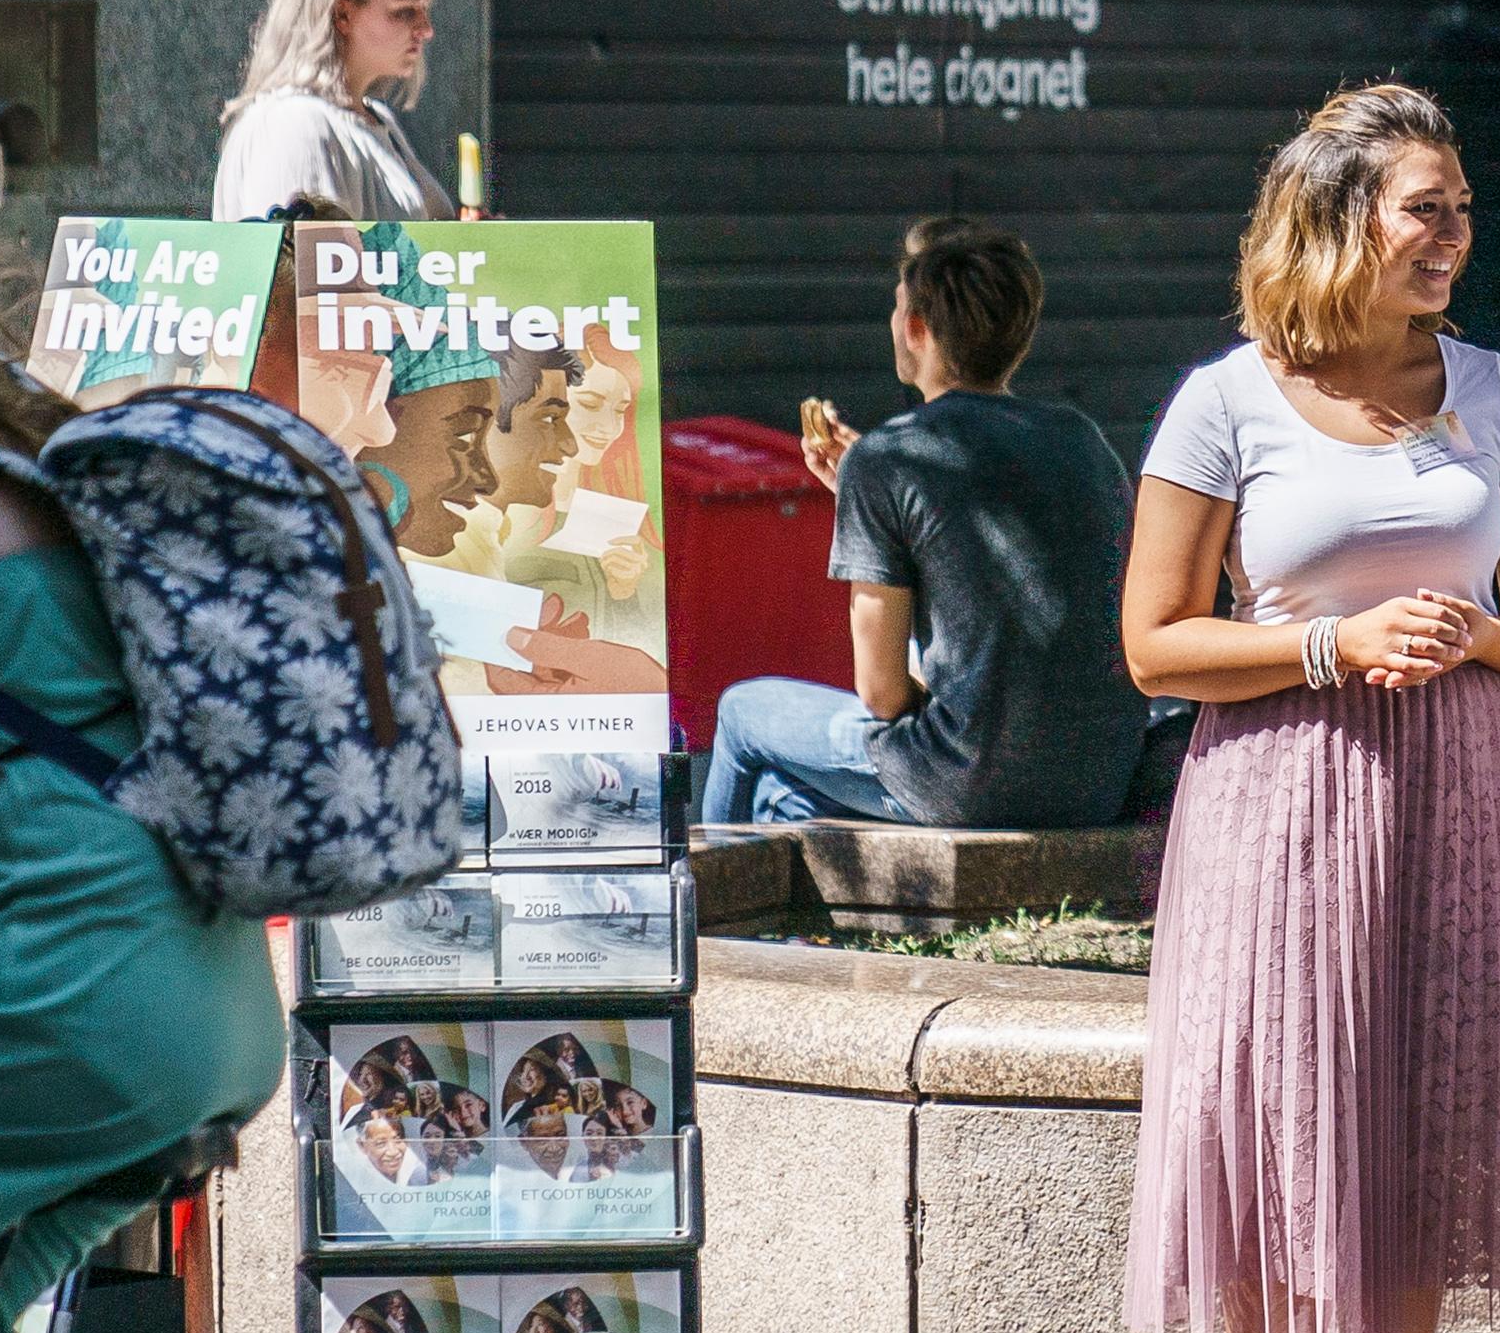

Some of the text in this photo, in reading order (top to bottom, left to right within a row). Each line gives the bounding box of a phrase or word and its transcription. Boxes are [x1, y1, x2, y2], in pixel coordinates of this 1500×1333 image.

[846, 41, 936, 106] hele
[64, 237, 220, 286] You Are
[314, 241, 487, 286] Du er
[44, 290, 258, 358] Invited
[316, 292, 642, 351] invitert
[476, 717, 634, 733] JEHOVAS VITNER
[514, 779, 553, 795] 2018
[508, 828, 543, 840] «VÆR
[345, 906, 384, 922] 2018
[524, 902, 562, 918] 2018
[518, 952, 552, 964] «VÆR
[359, 1189, 491, 1205] ET GODT BUDSKAP
[521, 1187, 652, 1201] ET GODT BUDSKAP
[433, 1206, 458, 1217] FRA
[593, 1203, 618, 1215] FRA
